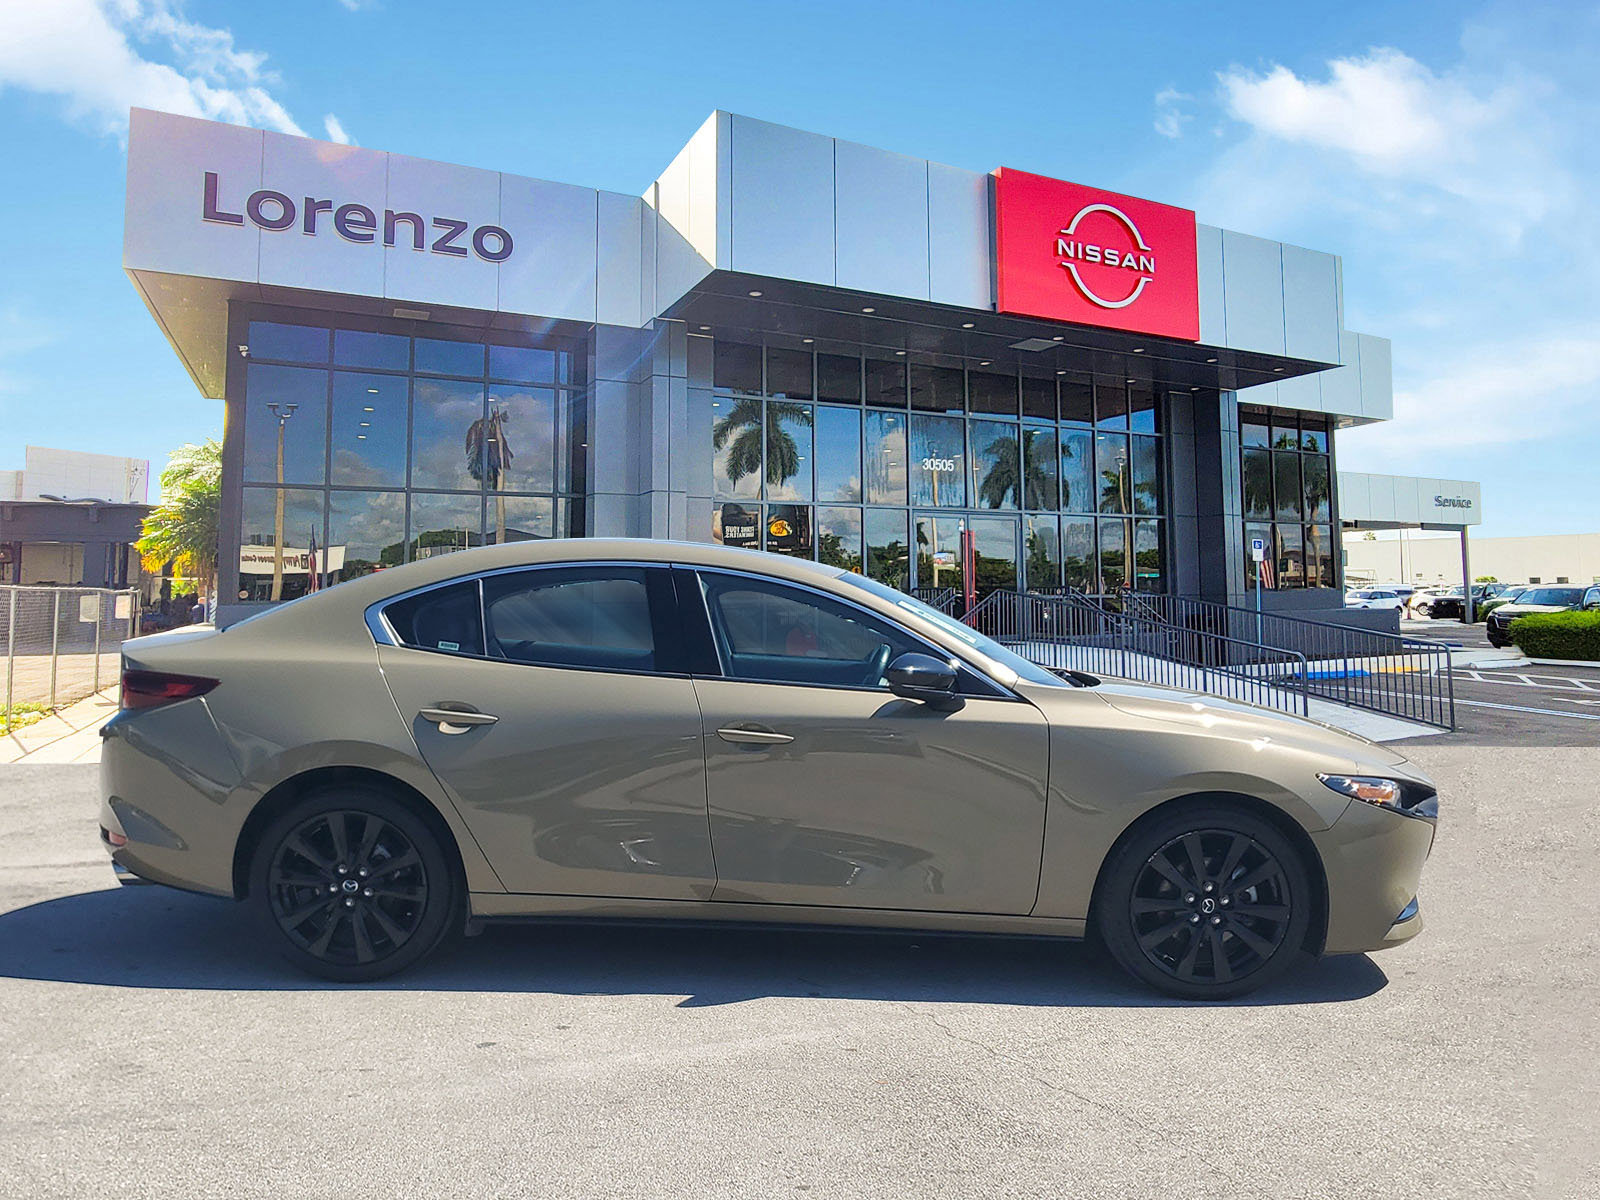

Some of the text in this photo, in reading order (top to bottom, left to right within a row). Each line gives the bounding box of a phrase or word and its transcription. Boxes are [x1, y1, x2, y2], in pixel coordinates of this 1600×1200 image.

[202, 171, 514, 263] Lorenzo
[1057, 238, 1155, 273] NISSAN
[922, 457, 954, 471] 30505
[1434, 495, 1472, 508] Service
